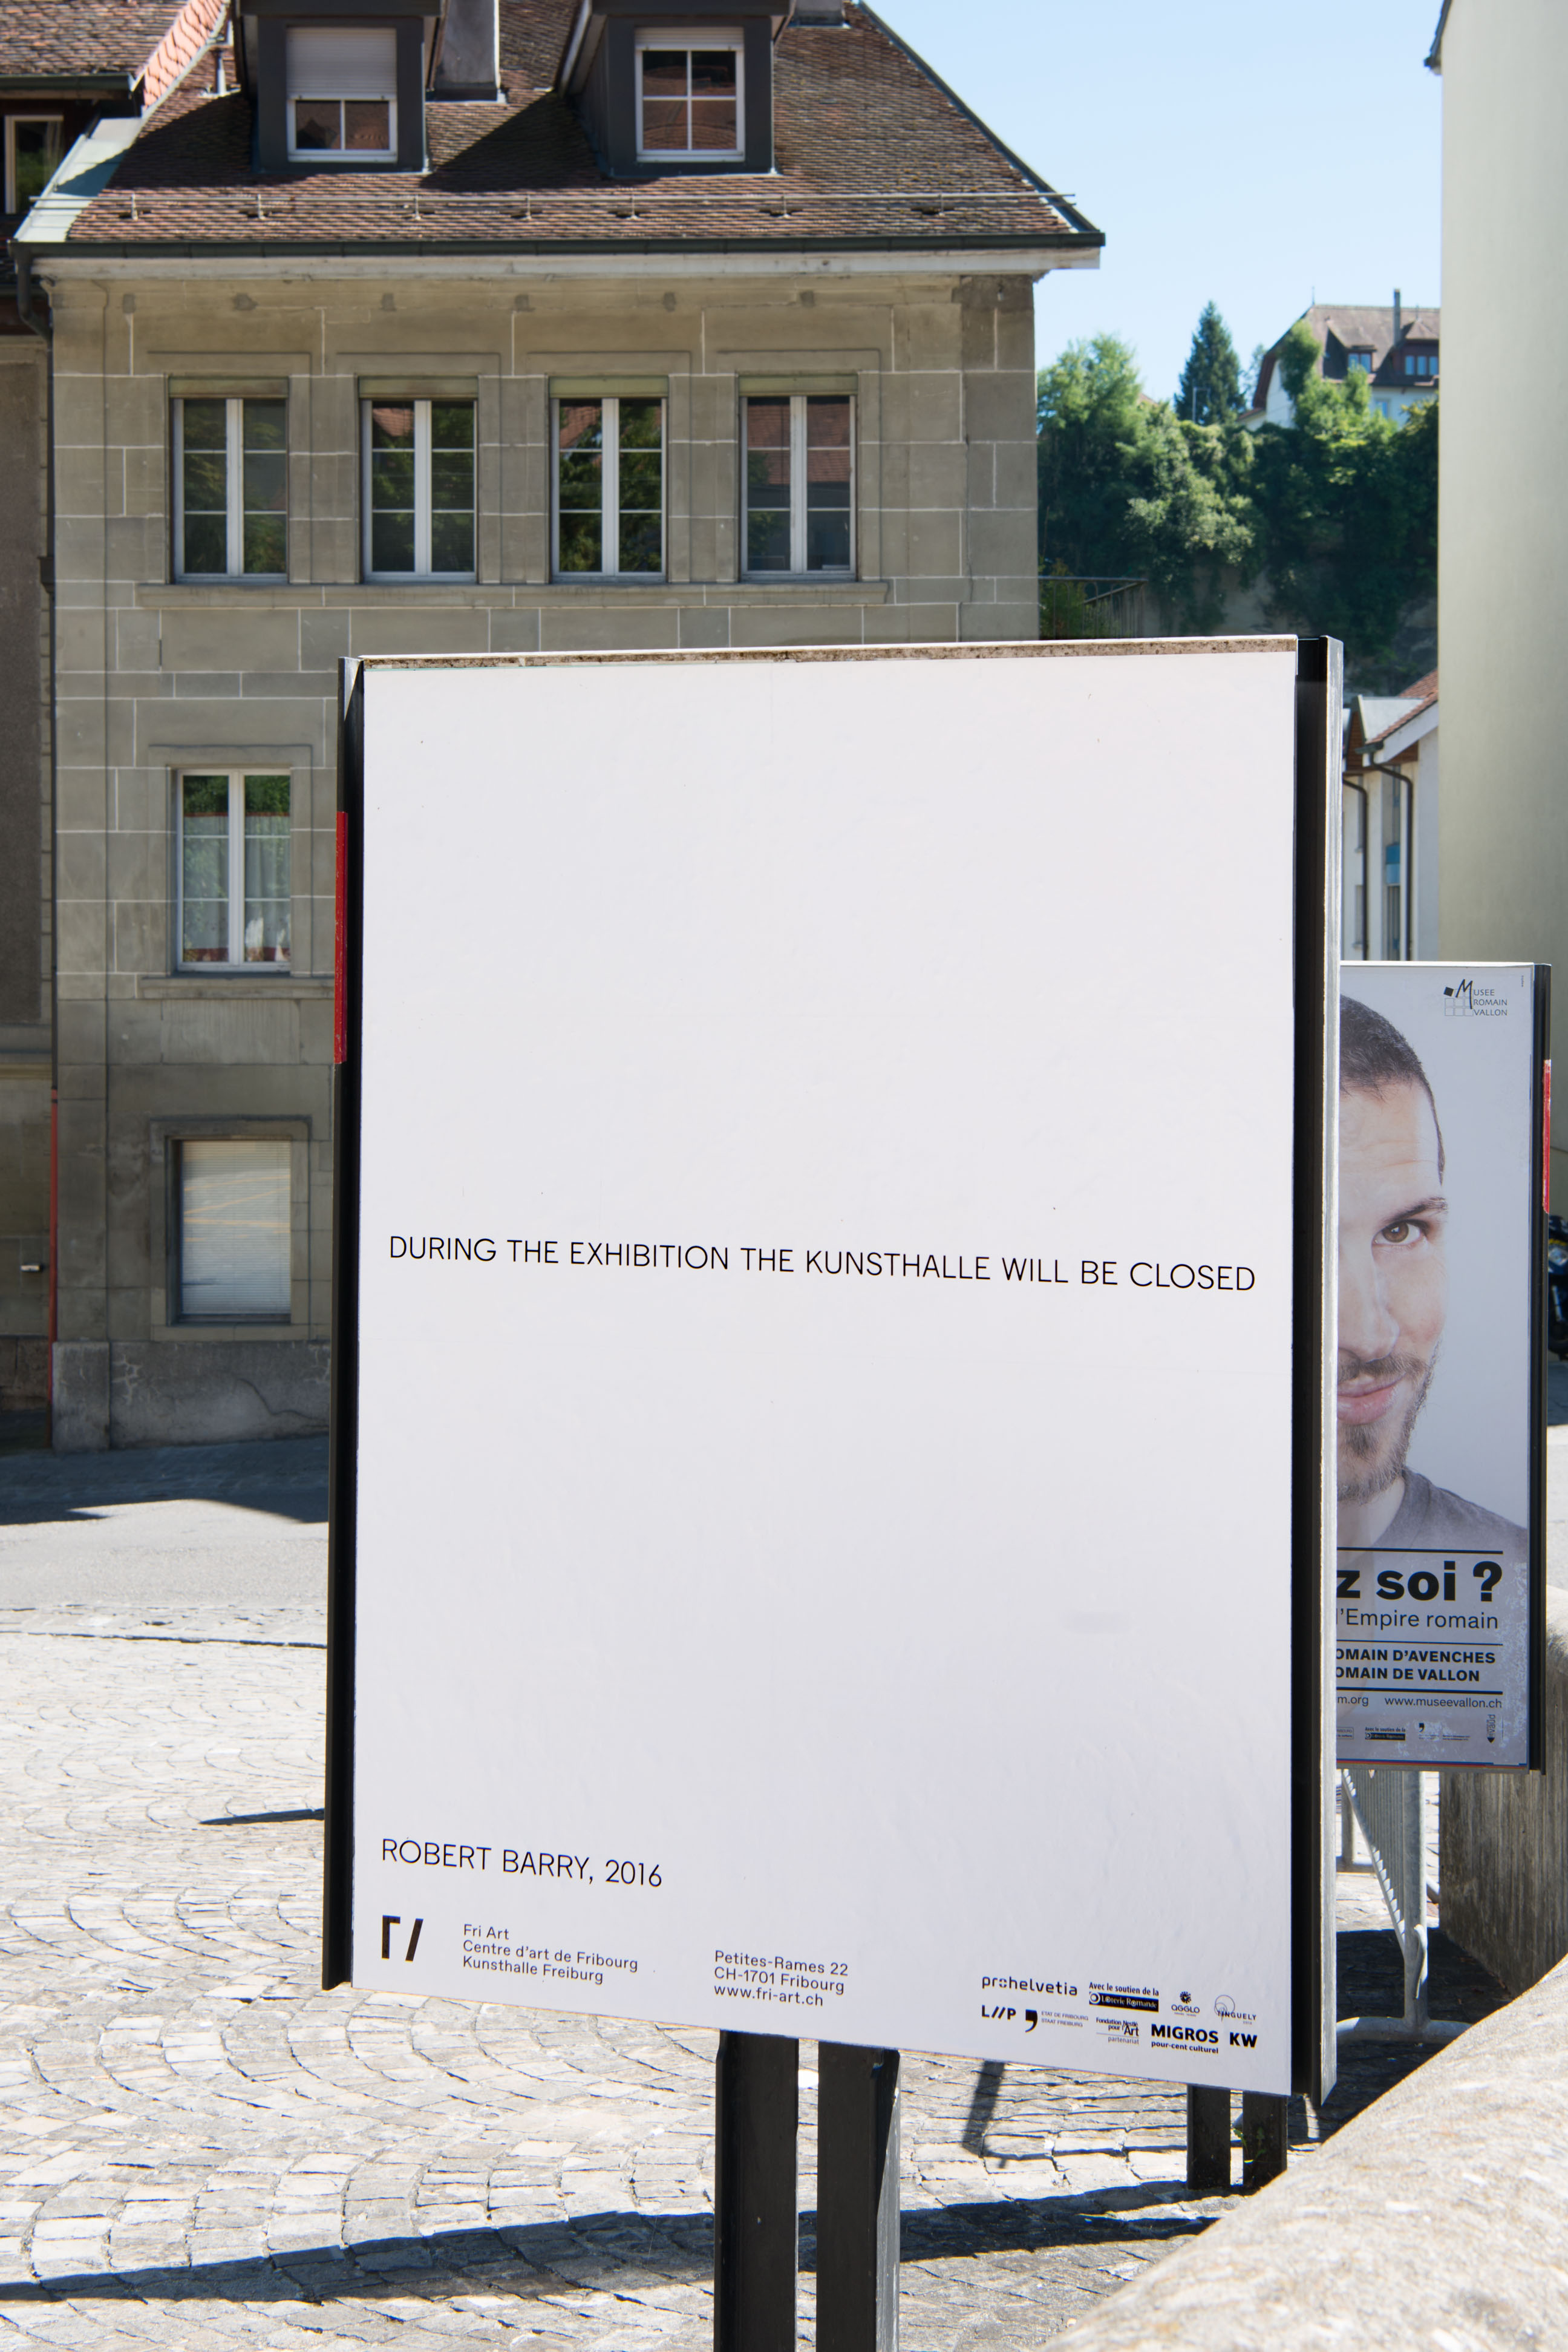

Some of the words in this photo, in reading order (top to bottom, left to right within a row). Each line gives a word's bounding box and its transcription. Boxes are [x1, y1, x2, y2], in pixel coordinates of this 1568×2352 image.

[390, 1236, 497, 1261] DURING
[507, 1240, 558, 1263] THE
[571, 1242, 728, 1269] EXHIBITION
[740, 1248, 794, 1272] THE
[806, 1250, 990, 1280] KUNSTHALLE
[1002, 1257, 1068, 1283] WILL
[1082, 1260, 1118, 1285] BE
[1129, 1262, 1255, 1291] CLOSED
[1376, 1561, 1455, 1601] soi
[1473, 1561, 1503, 1602] ?
[1427, 1612, 1498, 1629] romain
[1393, 1650, 1495, 1663] D’AVENCHES
[1393, 1668, 1414, 1680] DE
[1418, 1669, 1480, 1682] VALLON
[1385, 1697, 1502, 1708] www.museevallon.ch
[383, 1838, 492, 1870] ROBERT
[503, 1849, 593, 1885] BARRY,
[605, 1859, 662, 1887] 2016
[464, 1924, 482, 1938] Fri
[486, 1927, 509, 1940] Art
[463, 1940, 511, 1956] Centre
[516, 1946, 549, 1961] d’art
[554, 1950, 571, 1963] de
[577, 1951, 638, 1973] Fribourg
[715, 1950, 825, 1974] Petites-Rames
[830, 1962, 848, 1976] 22
[463, 1956, 538, 1975] Kunsthalle
[543, 1964, 603, 1985] Freiburg
[714, 1967, 774, 1985] CH-1701
[781, 1973, 844, 1995] Fribourg
[982, 1976, 1077, 1996] prohelvetia
[1089, 1982, 1105, 1990] Avec
[1106, 1983, 1113, 1991] le
[1116, 1986, 1140, 1994] soutien
[714, 1985, 823, 2006] www.fri-art.ch
[1102, 1996, 1125, 2005] Loterie
[1126, 1998, 1157, 2008] Romande
[1151, 2023, 1219, 2043] MIGROS
[1230, 2032, 1258, 2048] KW
[1151, 2041, 1187, 2050] pour-cent
[1189, 2045, 1218, 2054] culturel
